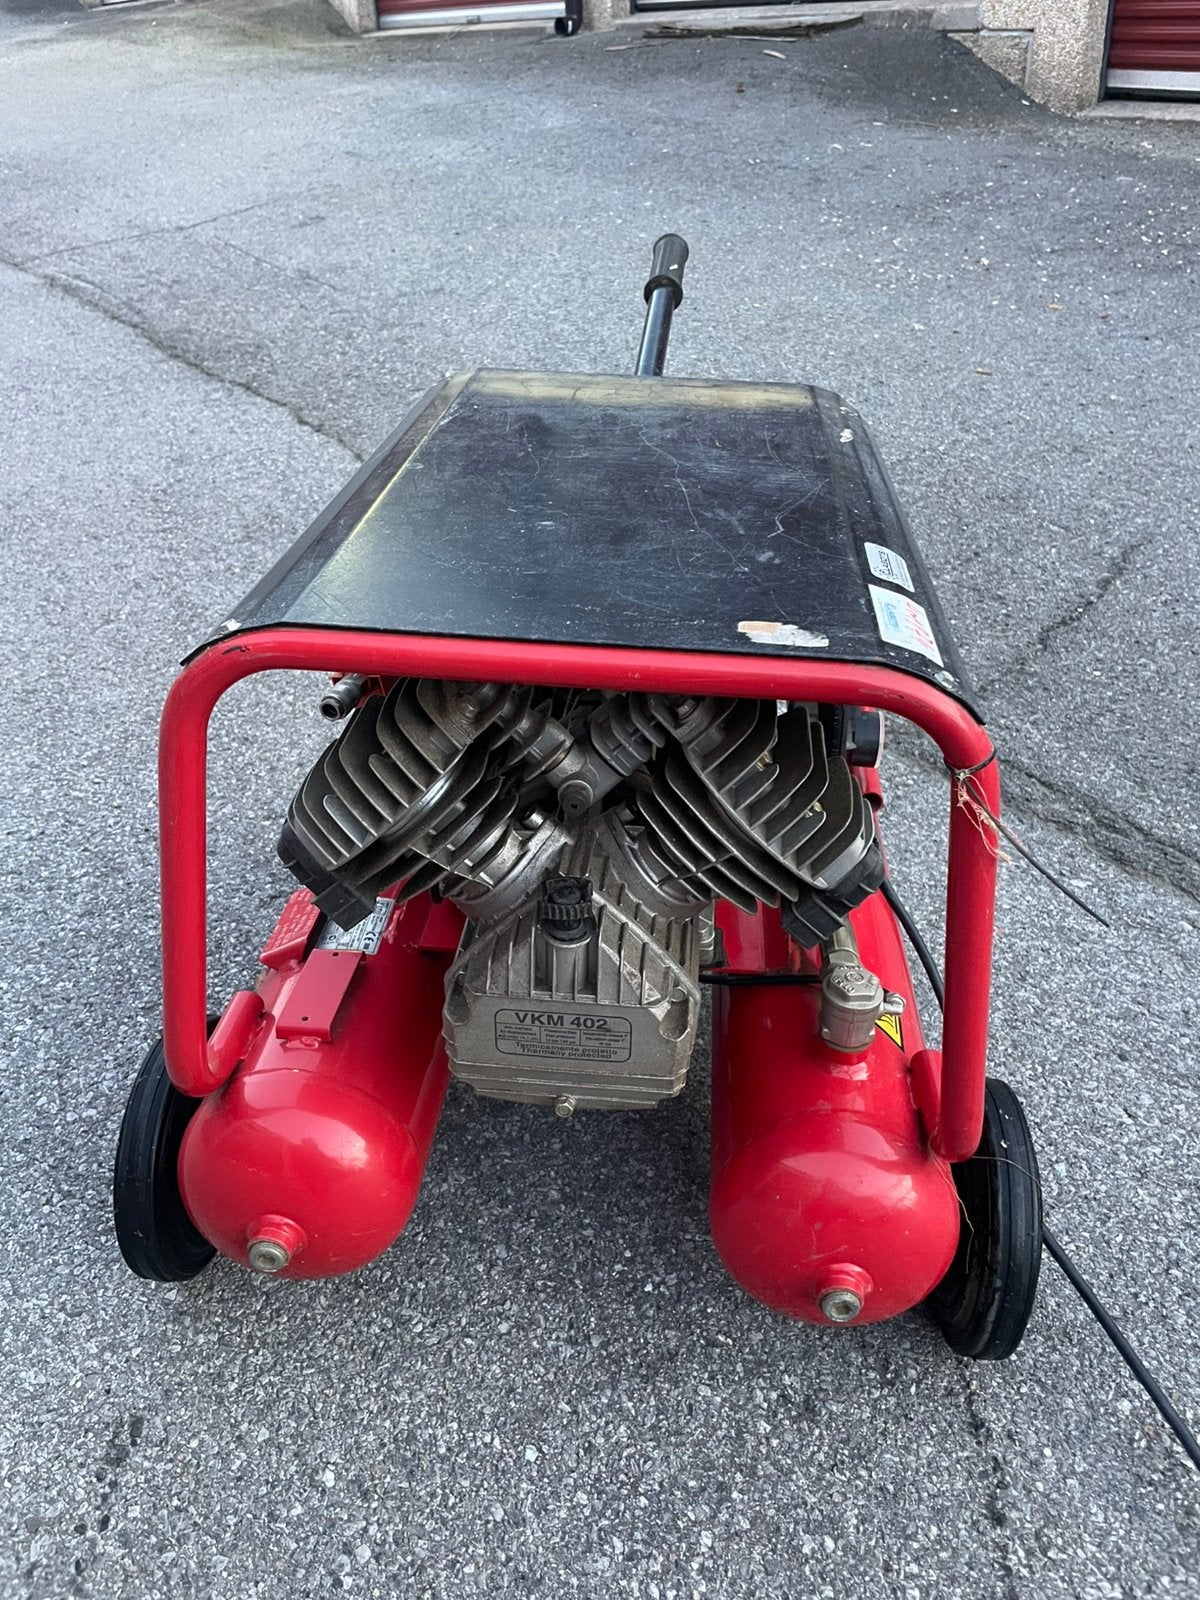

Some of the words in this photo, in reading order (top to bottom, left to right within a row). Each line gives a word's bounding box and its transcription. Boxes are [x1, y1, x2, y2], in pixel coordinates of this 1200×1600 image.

[514, 1012, 564, 1026] VKM
[570, 1016, 608, 1029] 402
[516, 1041, 579, 1051] Termicamente
[521, 1047, 566, 1057] Thermally
[569, 1051, 611, 1059] protected
